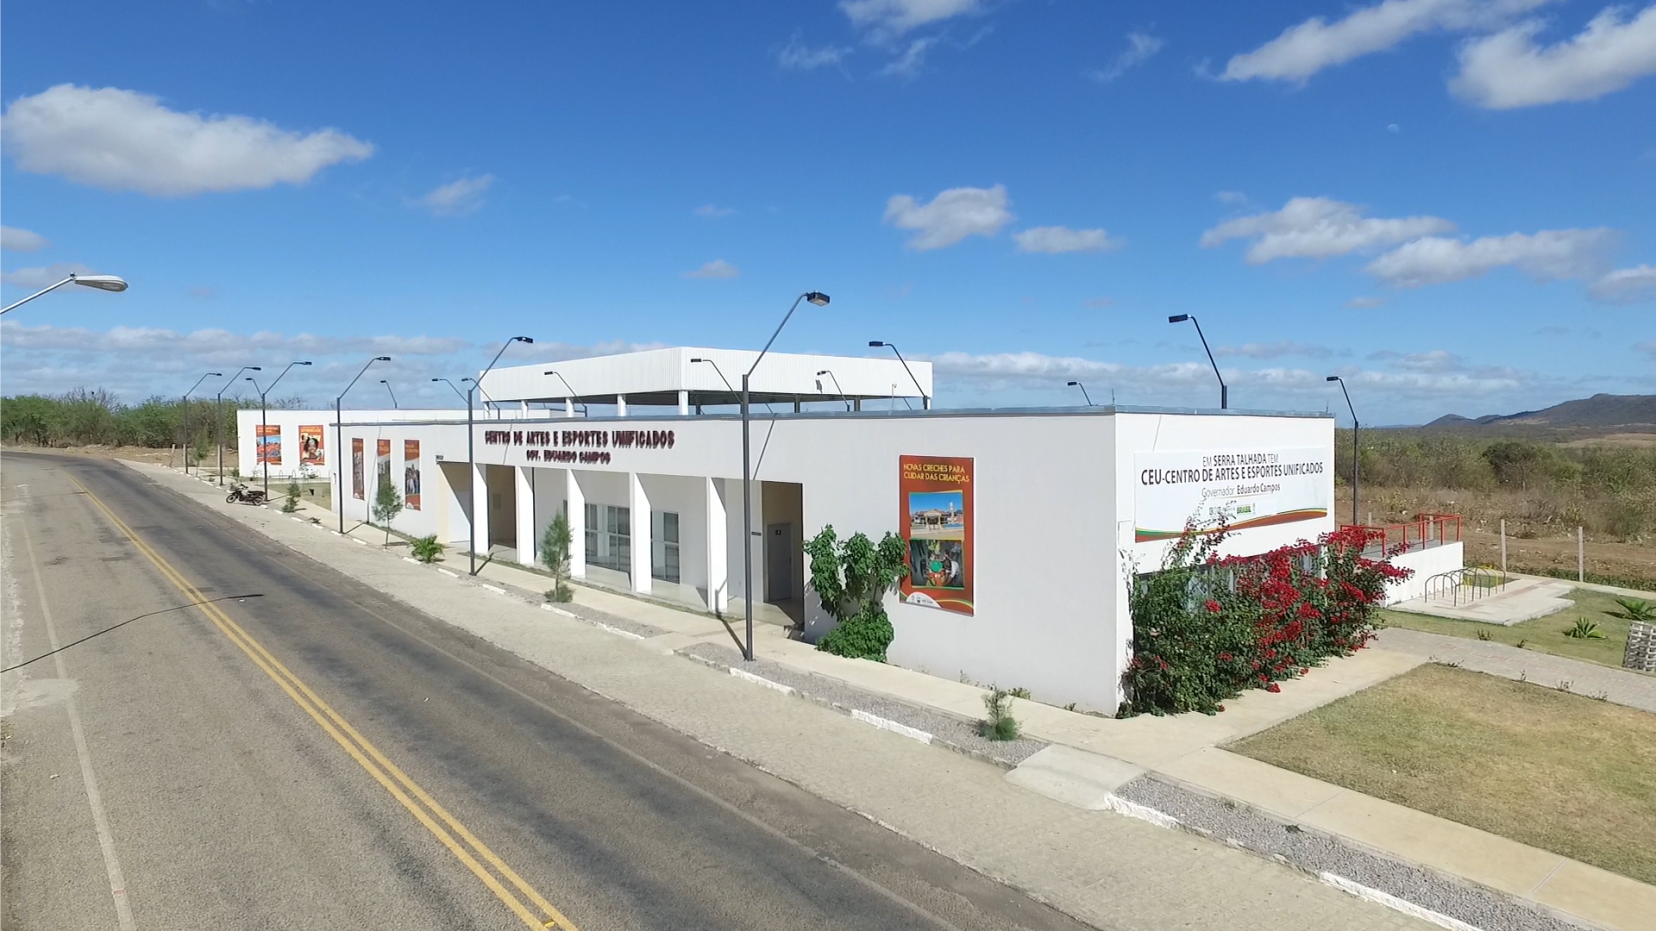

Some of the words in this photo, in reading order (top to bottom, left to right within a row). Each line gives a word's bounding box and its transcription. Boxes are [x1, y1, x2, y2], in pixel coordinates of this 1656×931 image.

[526, 430, 551, 447] ARTES
[553, 430, 559, 447] E
[561, 430, 608, 448] ESPORTES
[612, 430, 675, 449] UNIFICADOS
[1202, 456, 1212, 467] EM
[1213, 454, 1236, 467] SERRA
[1236, 453, 1267, 465] TALHADA
[1267, 453, 1279, 464] TEM
[903, 463, 922, 471] NOVAS
[922, 464, 948, 472] CRECHES
[948, 465, 965, 473] PARA
[1202, 468, 1213, 482] DE
[1215, 467, 1240, 481] ARTES
[1241, 466, 1246, 479] E
[1247, 464, 1283, 479] ESPORTES
[1283, 461, 1324, 476] UNIFICADOS
[903, 471, 925, 479] CUIDAR
[925, 473, 938, 481] DAS
[938, 473, 970, 484] CRIANÇAS
[1201, 485, 1235, 498] Governador
[1236, 484, 1259, 495] Eduardo
[1260, 482, 1280, 494] Campos
